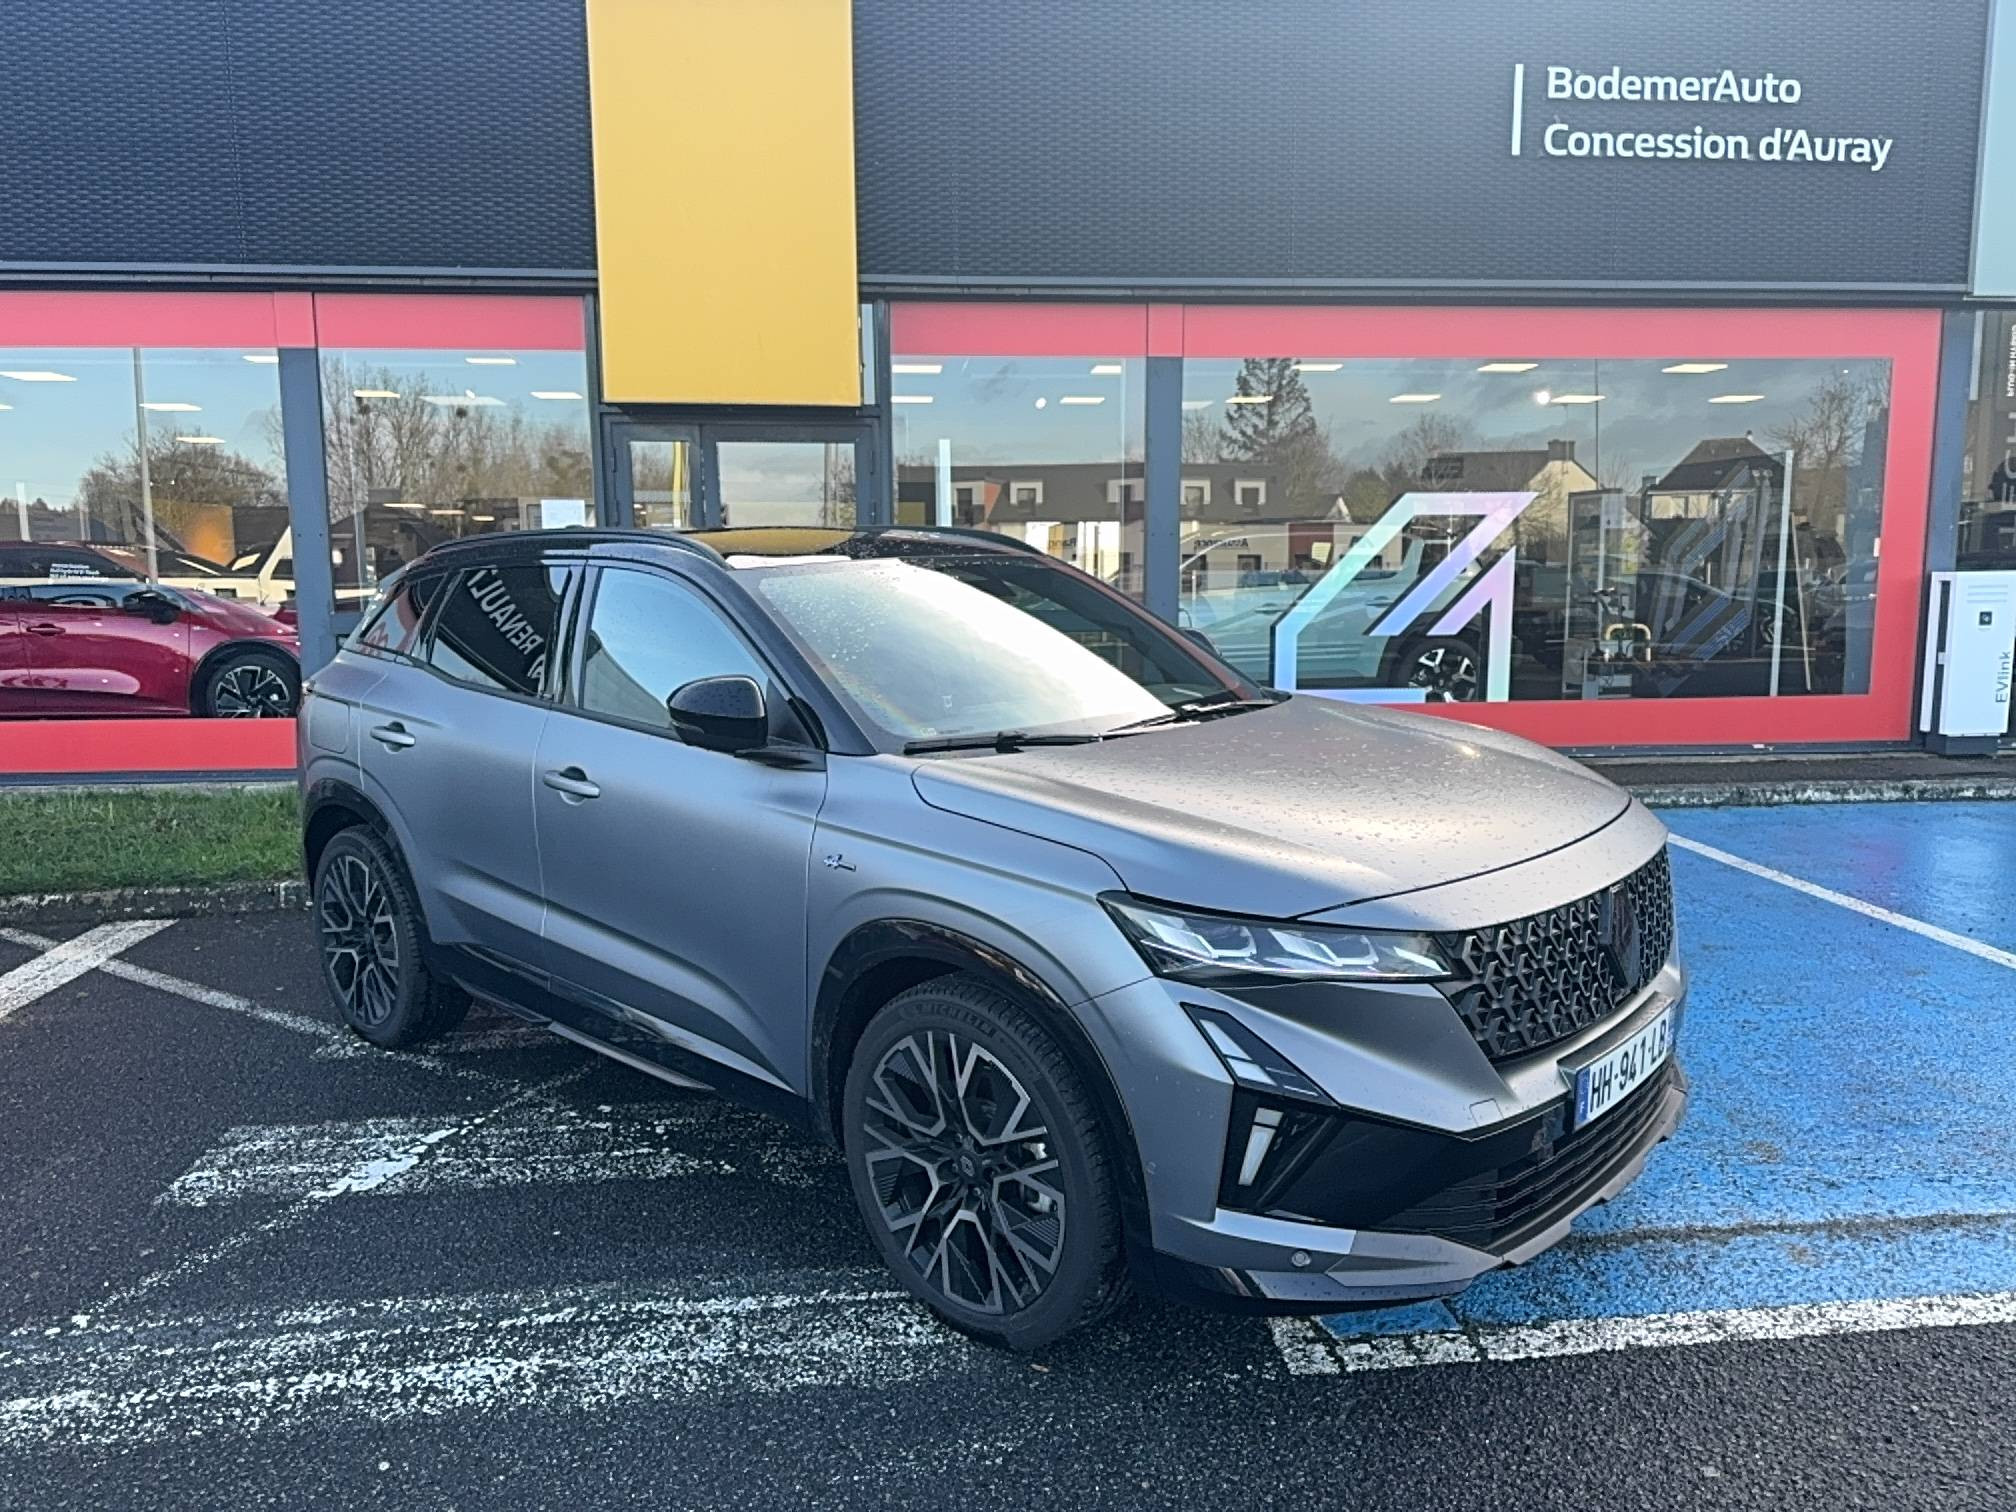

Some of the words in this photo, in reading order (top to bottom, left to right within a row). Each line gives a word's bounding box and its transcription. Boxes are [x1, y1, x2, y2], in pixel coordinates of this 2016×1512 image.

[1547, 66, 1802, 104] BodemerAuto
[1544, 124, 1749, 160] Concession
[1759, 127, 1893, 172] d'Auray
[1590, 1019, 1667, 1113] HH-941-LB
